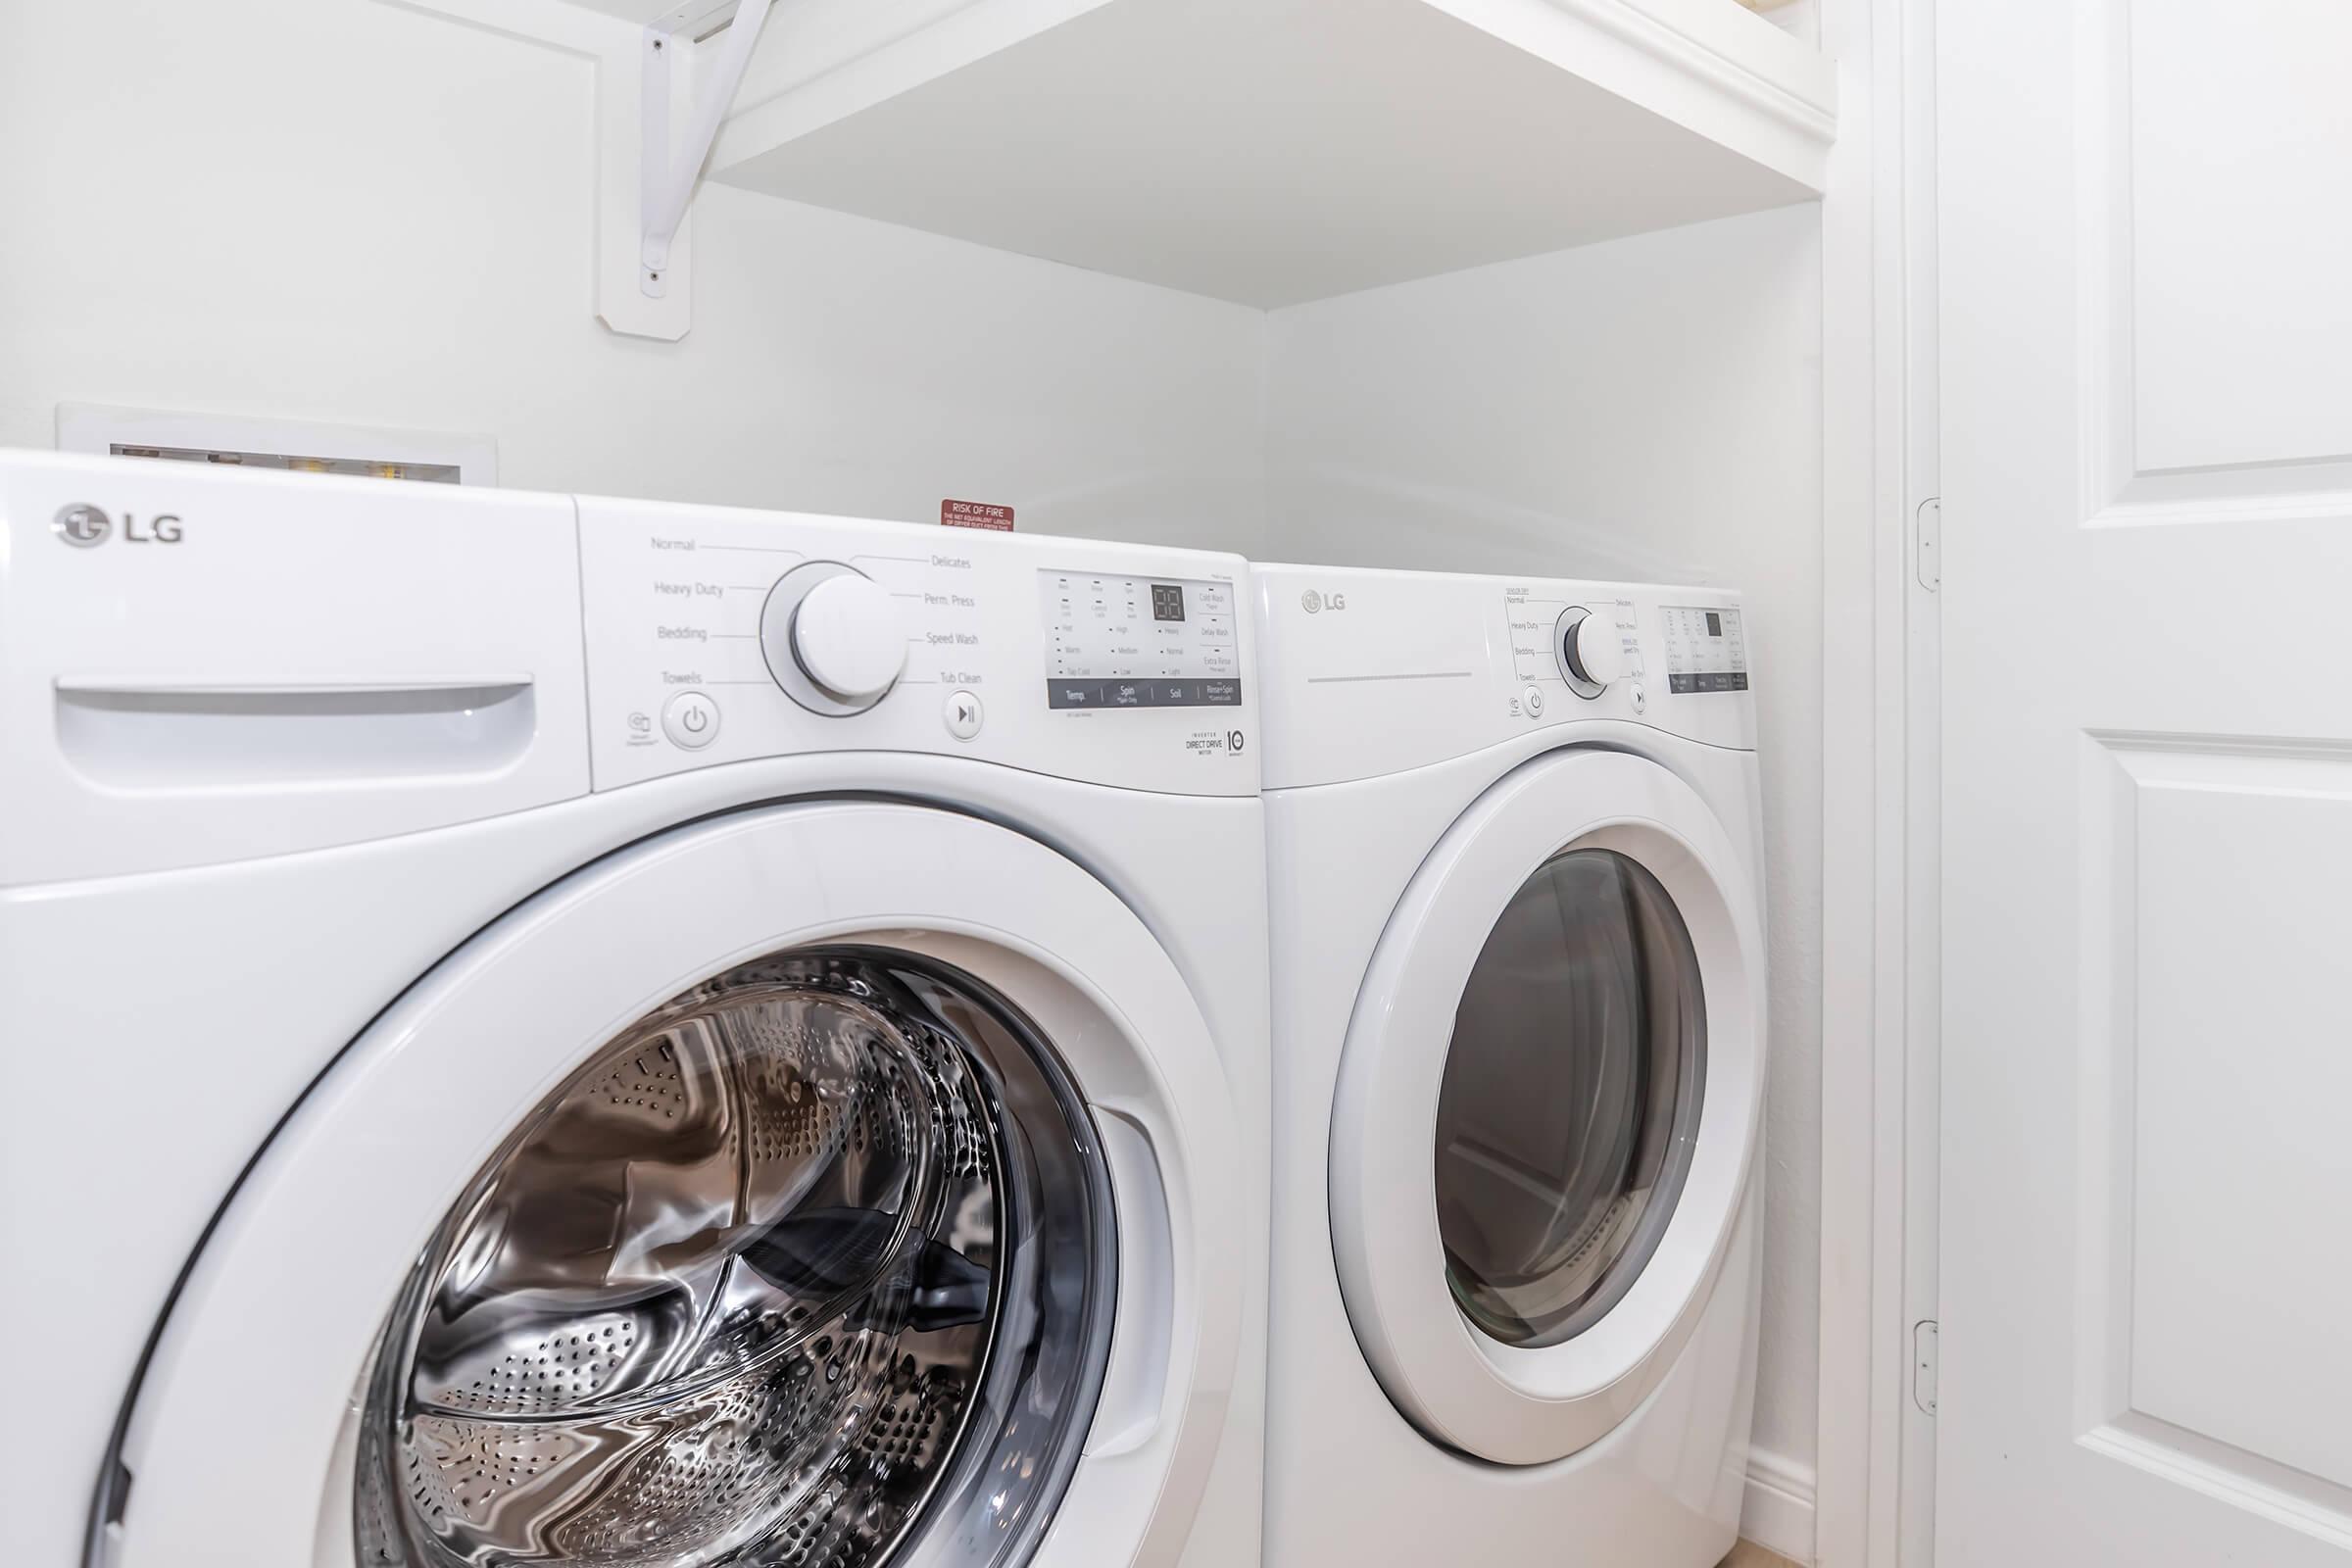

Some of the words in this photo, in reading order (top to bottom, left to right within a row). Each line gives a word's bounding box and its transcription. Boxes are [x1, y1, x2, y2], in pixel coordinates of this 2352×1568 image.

[953, 503, 971, 514] RISK
[972, 505, 984, 514] OF
[986, 507, 1004, 517] FIRE
[123, 513, 183, 543] LG
[651, 537, 695, 551] Normal
[932, 556, 971, 569] Delicates
[654, 581, 692, 597] Heavy
[695, 582, 724, 598] Duty
[924, 593, 949, 605] Perm.
[952, 595, 975, 607] Press
[1323, 593, 1346, 611] LG
[657, 625, 708, 642] Bedding
[925, 632, 954, 645] Speed
[955, 633, 978, 645] Wash
[1515, 648, 1535, 657] Bedding
[661, 671, 703, 684] Towels
[940, 672, 956, 683] Tub
[957, 673, 982, 684] Clean
[1066, 690, 1086, 702] Temp.
[1120, 686, 1136, 696] Spin
[1169, 688, 1182, 699] Soil
[1186, 740, 1205, 749] DIRECT
[1205, 739, 1223, 748] DRIVE
[1227, 730, 1245, 751] 10
